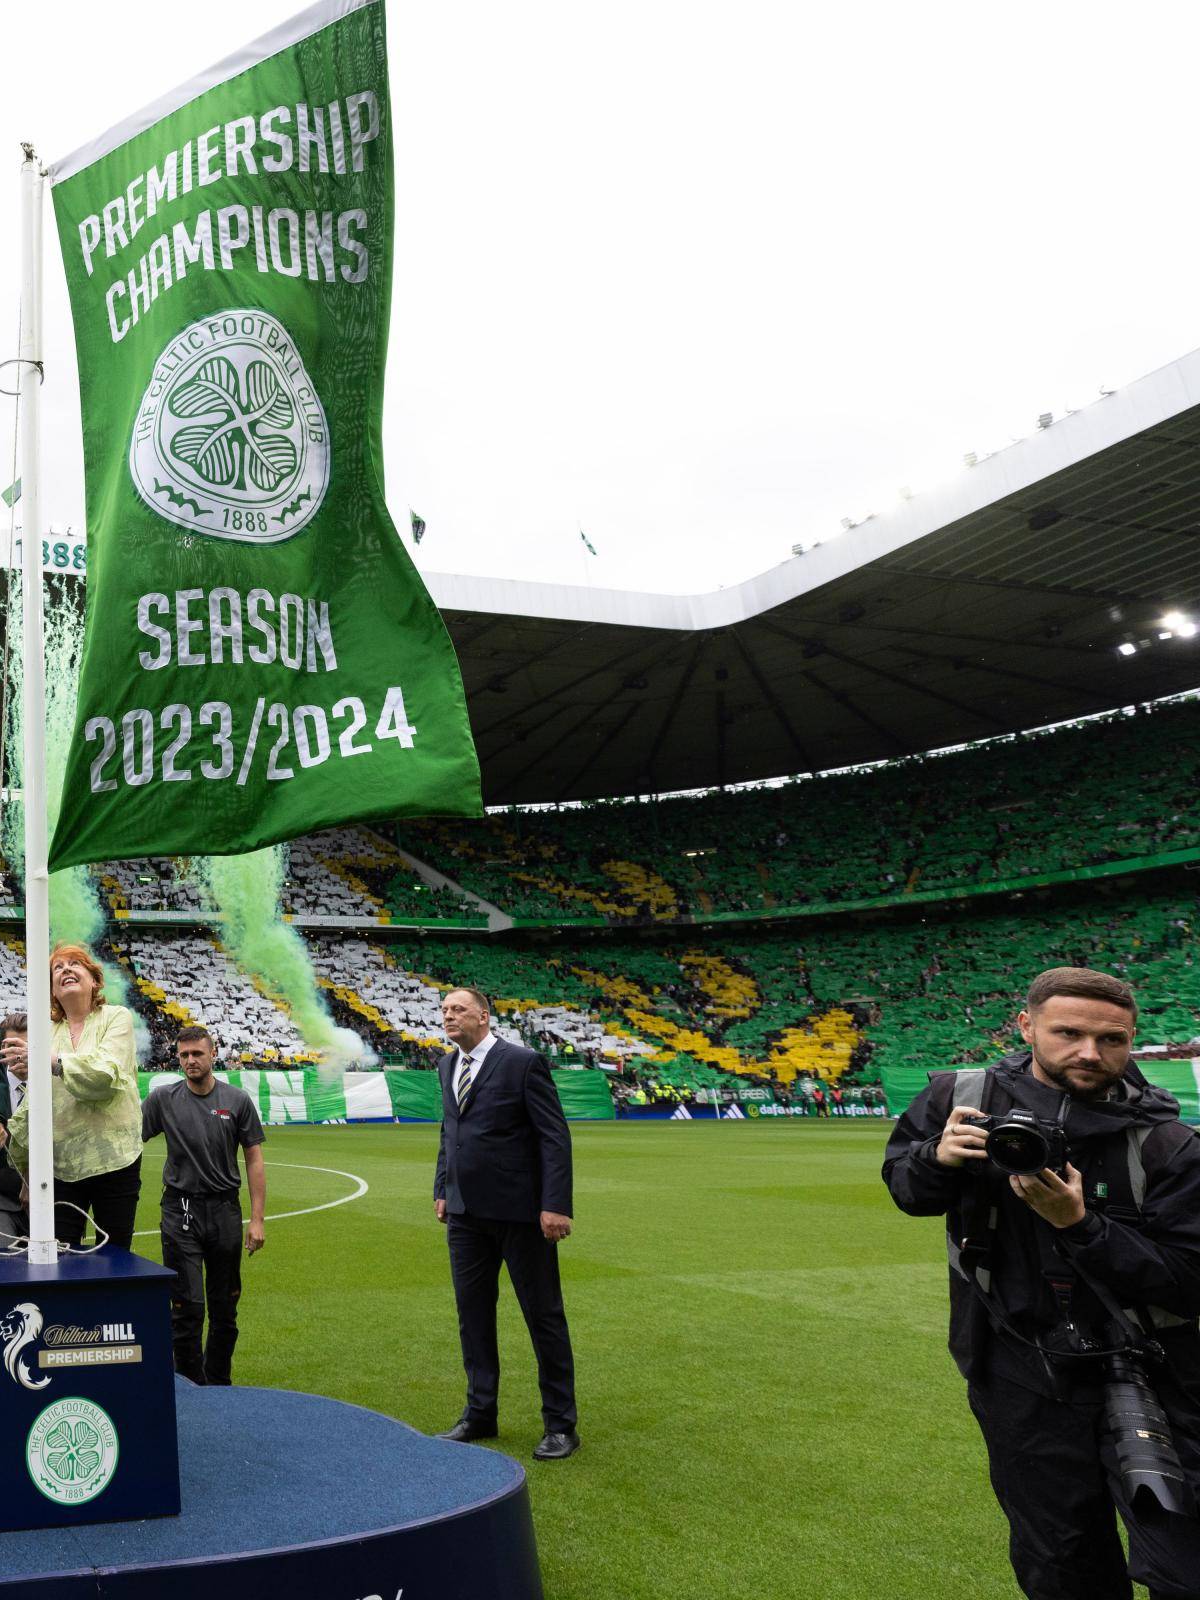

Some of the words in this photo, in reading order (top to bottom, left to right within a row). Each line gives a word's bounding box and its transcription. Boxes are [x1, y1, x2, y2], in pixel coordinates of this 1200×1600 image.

[78, 90, 380, 277] PREMIERSHIP
[105, 203, 370, 343] CHAMPIONS
[136, 406, 158, 448] THE
[150, 331, 205, 398] CELTIC
[208, 316, 301, 384] FOOTBALL
[297, 386, 324, 444] CLUB
[222, 508, 268, 533] 1888
[137, 587, 338, 673] SEASON
[84, 686, 418, 793] 2023/2024
[739, 1088, 771, 1099] GREEN
[43, 1324, 103, 1346] William
[103, 1323, 135, 1341] HILL
[47, 1348, 134, 1364] PREMIERSHIP
[31, 1434, 41, 1453] THE
[36, 1407, 61, 1434] CELTIC
[61, 1402, 102, 1425] FOOTBALL
[100, 1423, 114, 1448] CLUB
[64, 1488, 84, 1499] 1888
